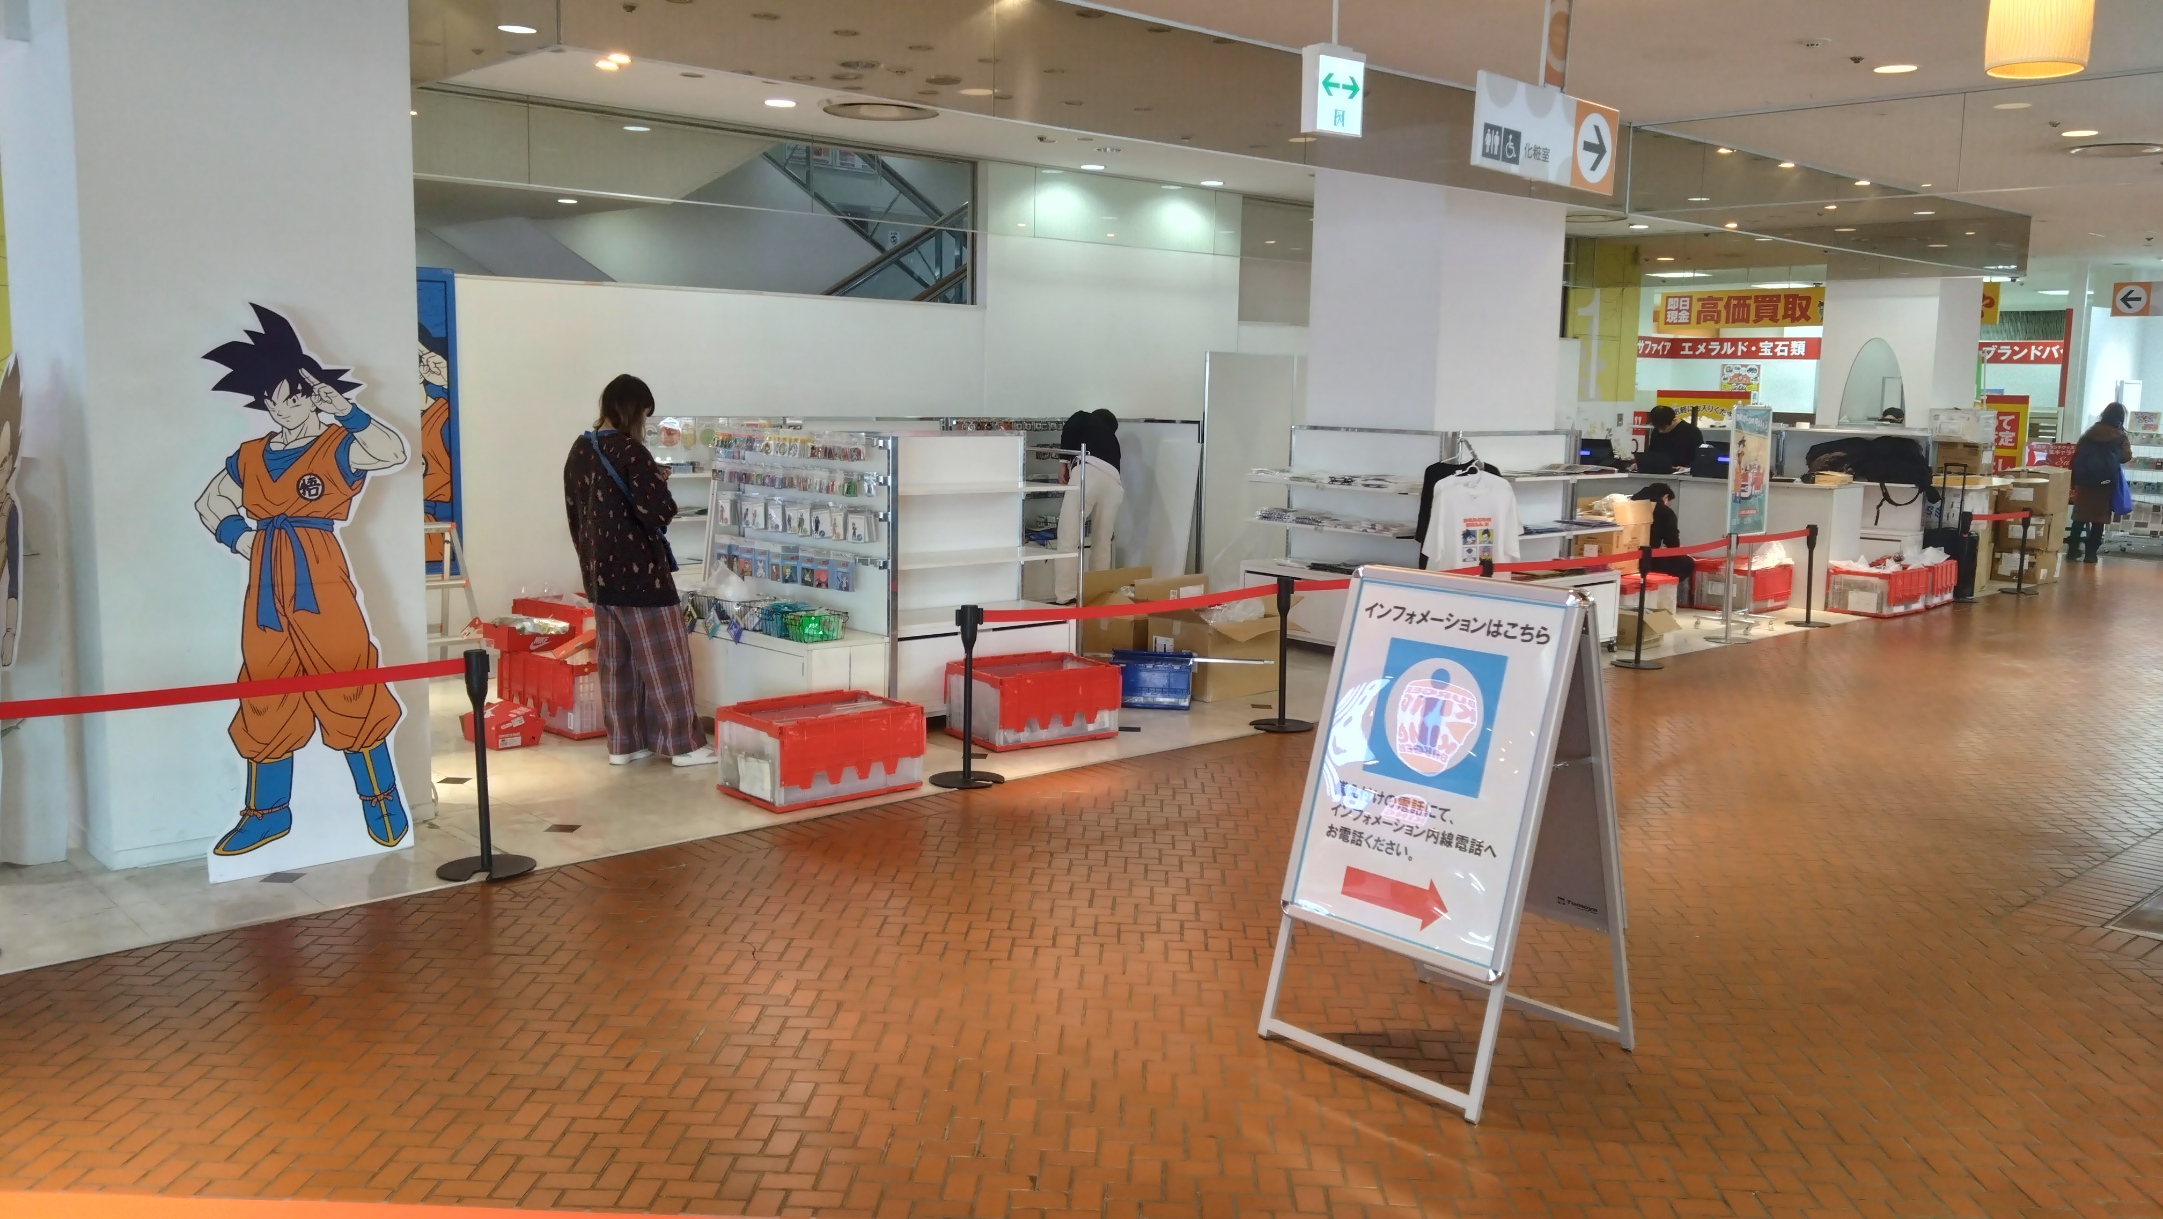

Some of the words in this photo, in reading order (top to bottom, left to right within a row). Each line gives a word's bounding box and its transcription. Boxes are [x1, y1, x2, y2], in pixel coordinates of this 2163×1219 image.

[1667, 297, 1690, 310] 即日
[1696, 294, 1812, 325] 高価買取
[1666, 310, 1690, 323] 現金
[1637, 340, 1671, 355] サファイア
[1680, 340, 1807, 357] エメラルド・宝石類
[1983, 344, 2063, 361] ブランドバ
[1364, 601, 1551, 646] インフォメーションはこちら
[1325, 824, 1413, 861] お電話ください。
[1331, 803, 1497, 859] インフォメーション内線電話へ
